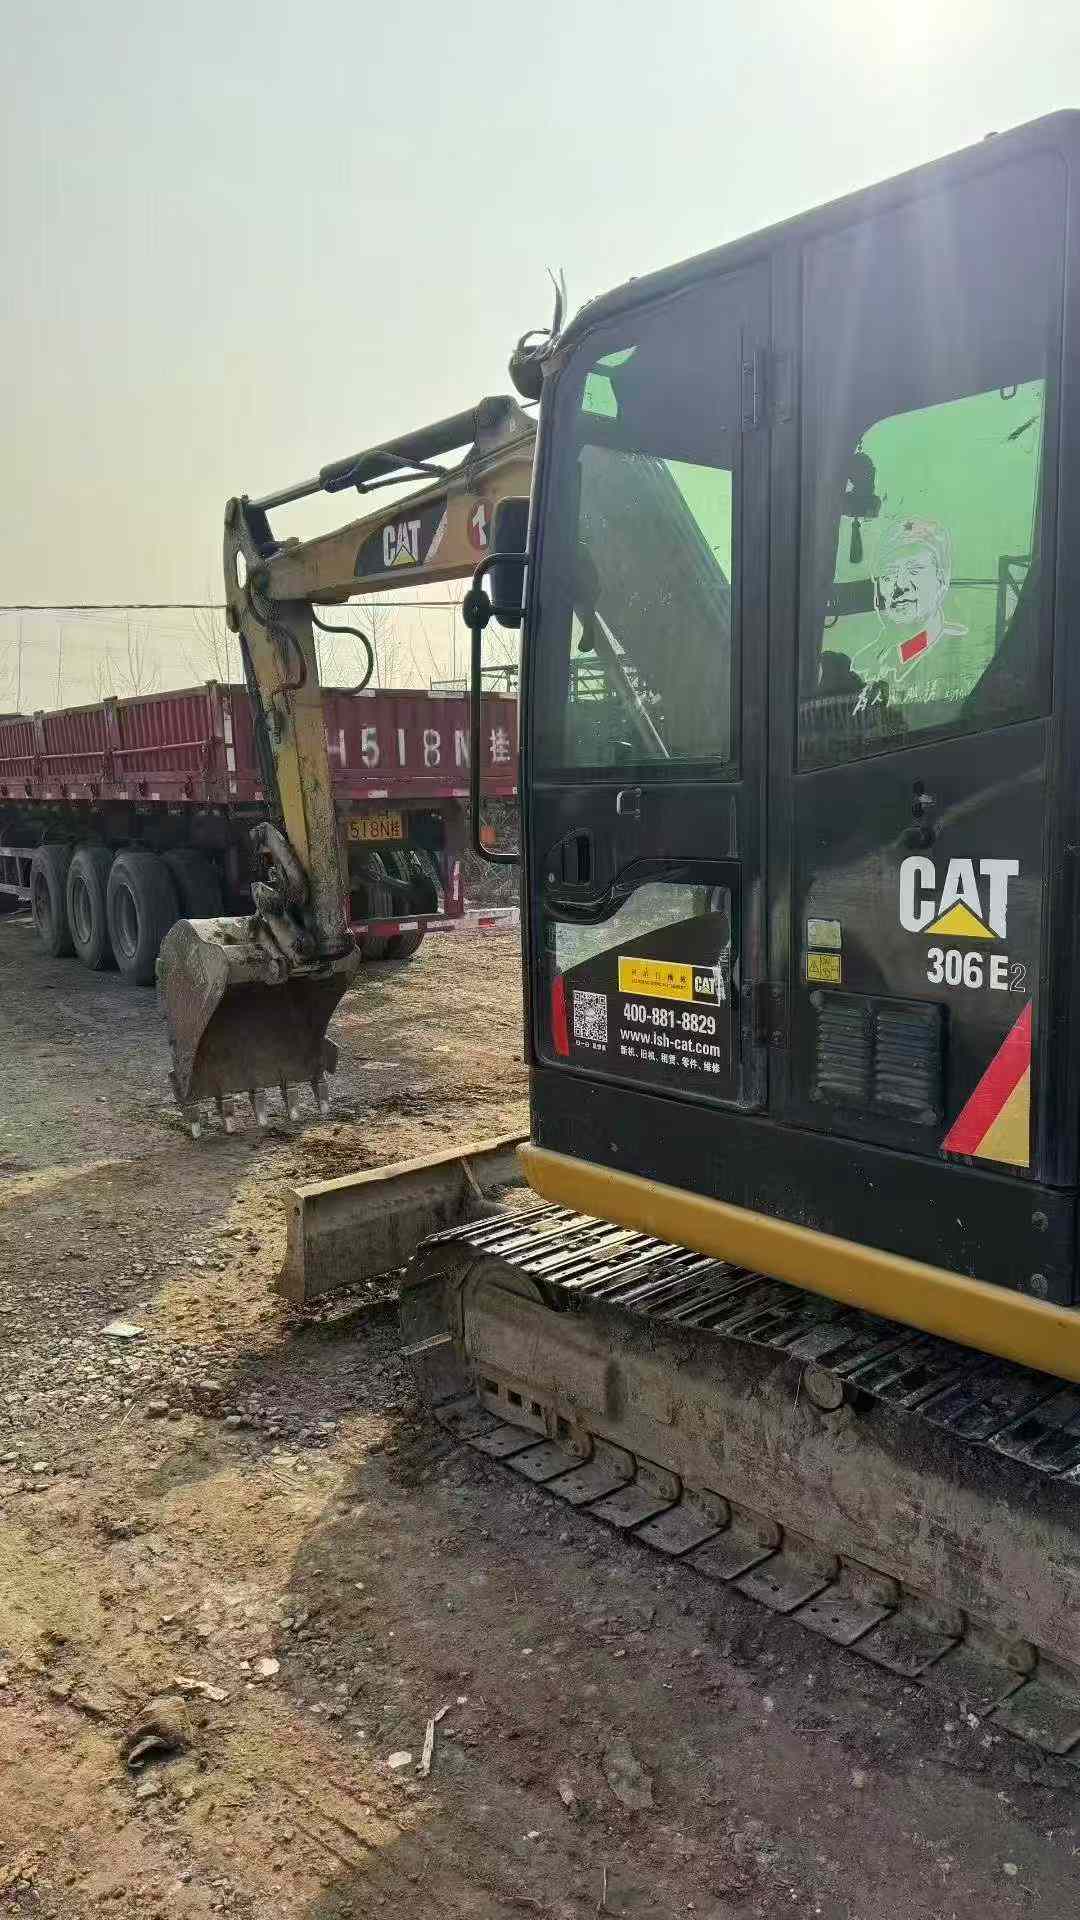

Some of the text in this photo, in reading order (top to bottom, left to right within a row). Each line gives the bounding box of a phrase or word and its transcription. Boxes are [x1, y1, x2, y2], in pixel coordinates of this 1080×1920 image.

[382, 519, 422, 567] CAT
[900, 855, 1020, 939] CAT
[623, 1002, 717, 1036] 400-881-8829
